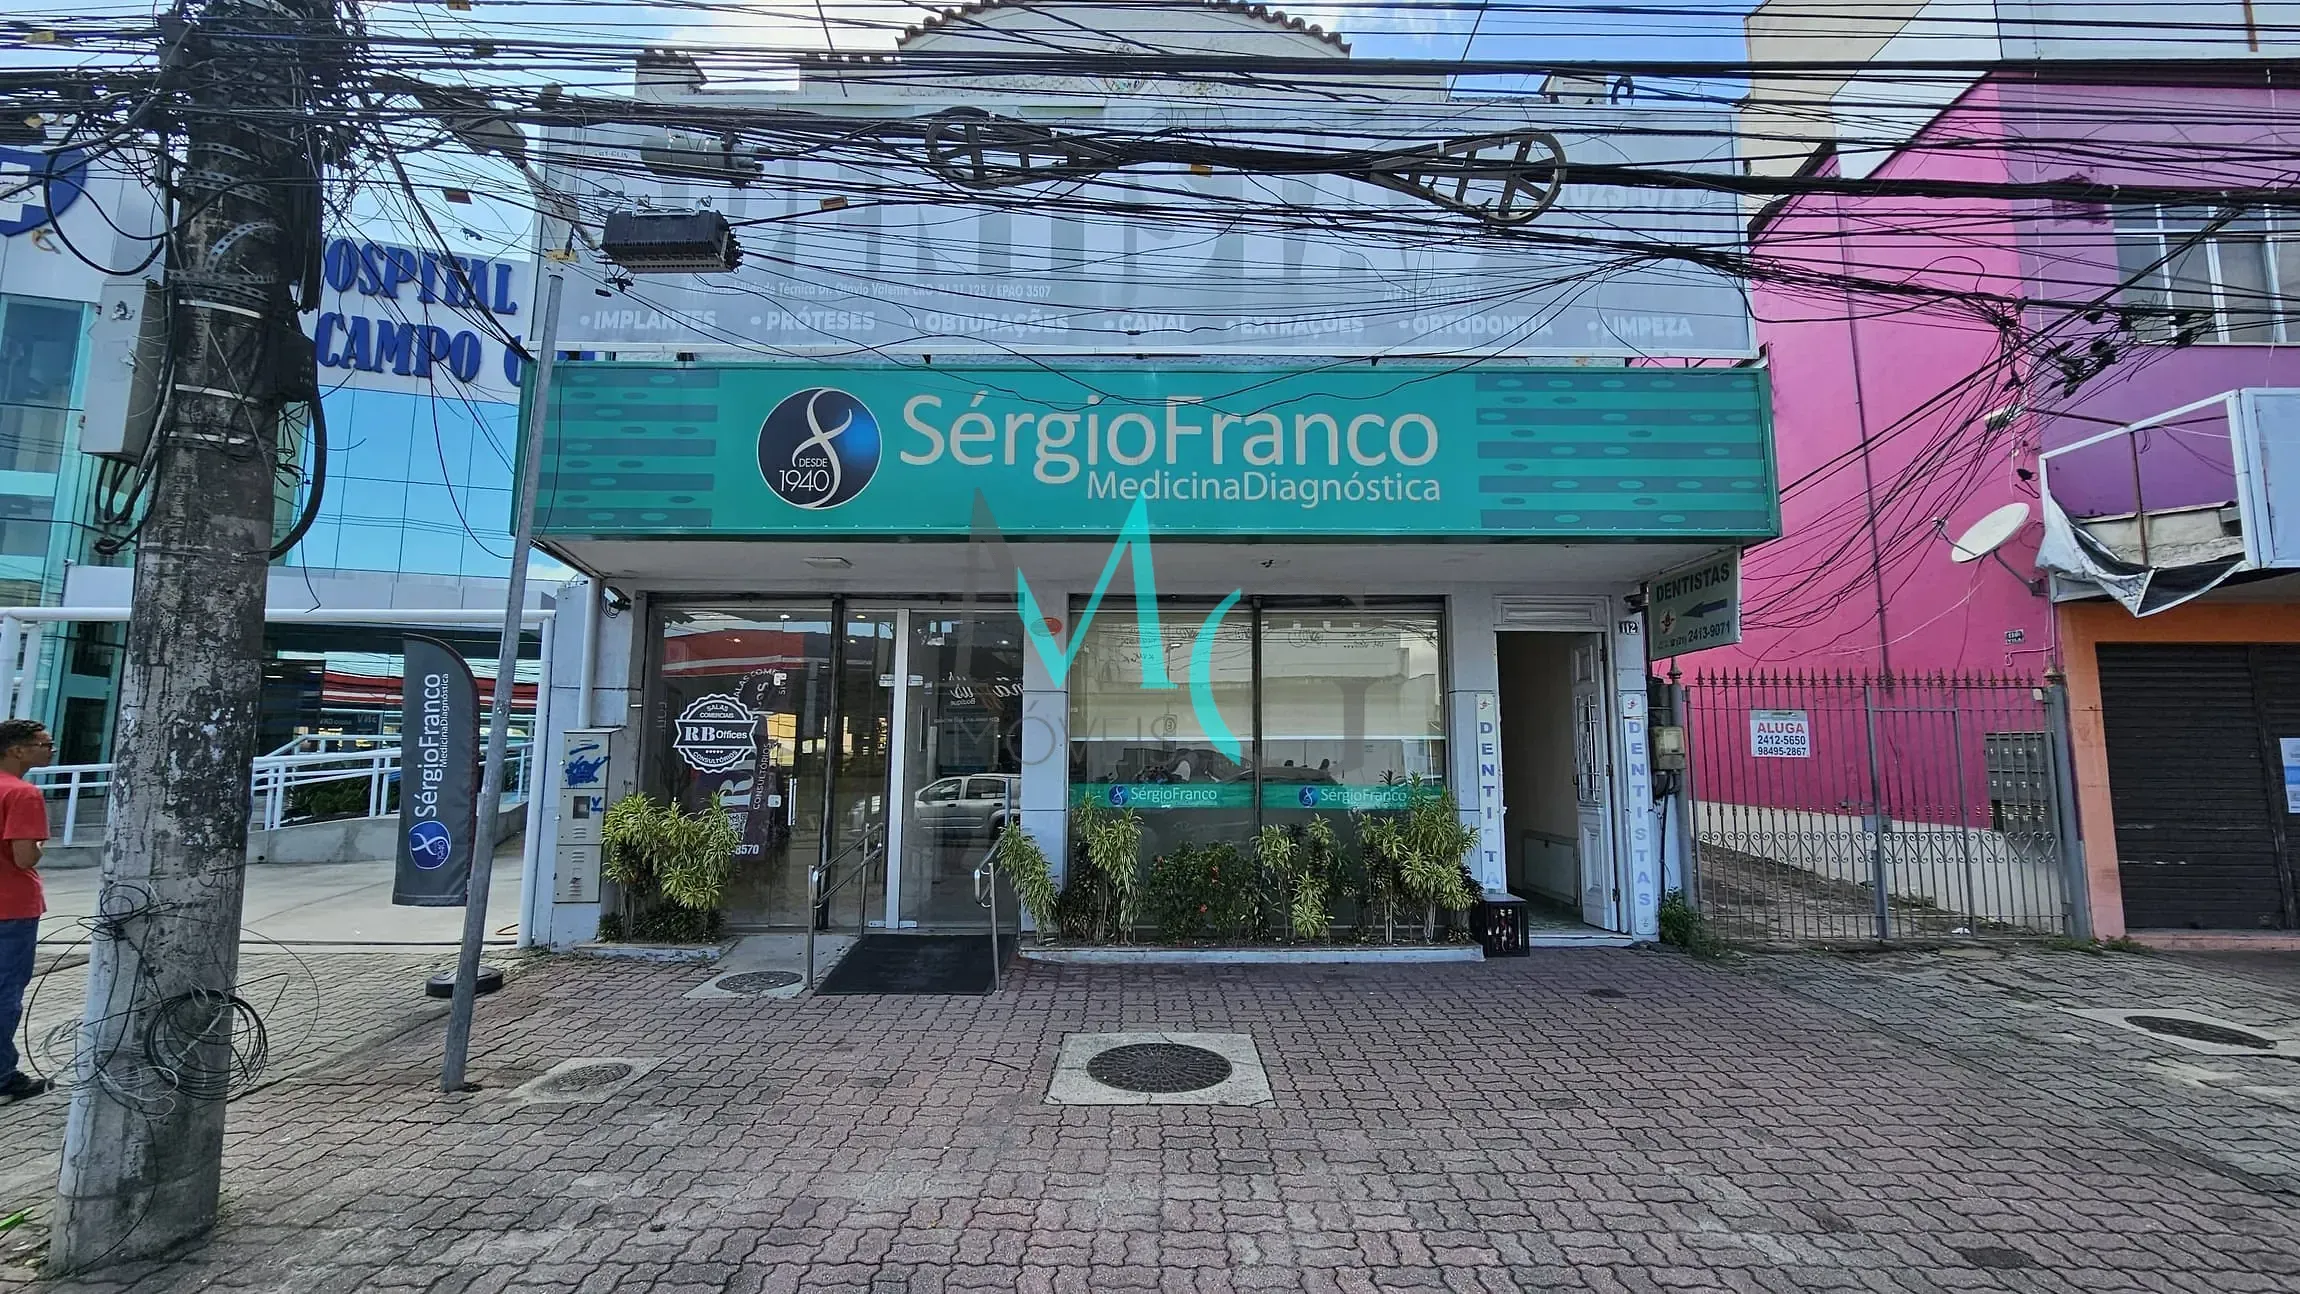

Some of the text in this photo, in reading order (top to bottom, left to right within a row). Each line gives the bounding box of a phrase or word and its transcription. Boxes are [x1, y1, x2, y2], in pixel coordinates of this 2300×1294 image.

[325, 238, 517, 315] OSPITAL
[1026, 285, 1052, 297] 3507
[594, 311, 718, 331] IMPLANTES
[766, 307, 876, 331] PRÓTESES
[924, 309, 1069, 336] OBTURAÇÕES
[1118, 315, 1188, 334] CANAL
[1240, 312, 1365, 339] EXTRAÇÕES
[1412, 316, 1554, 337] ORTODONTIA
[1602, 317, 1694, 338] LIMPEZA
[315, 311, 482, 383] CAMPO
[900, 390, 1439, 485] SérgioFranco
[798, 457, 828, 468] DESDE
[779, 469, 830, 492] 1940
[1086, 469, 1441, 509] MedicinaDiagnóstica
[1655, 562, 1730, 603] DENTISTAS
[1687, 620, 1730, 643] 2413-9071
[706, 703, 729, 712] SALAS
[684, 726, 748, 742] RB Offices
[1757, 722, 1805, 734] ALUGA
[414, 673, 443, 818] SérgioFranco
[1757, 735, 1806, 745] 2412-5650
[692, 750, 738, 764] CONSULTÓRIOS
[1757, 746, 1807, 756] 98495-2867
[1130, 786, 1218, 802] SérgioFranco
[1627, 720, 1652, 907] DENTISTAS
[728, 844, 760, 856] -8570
